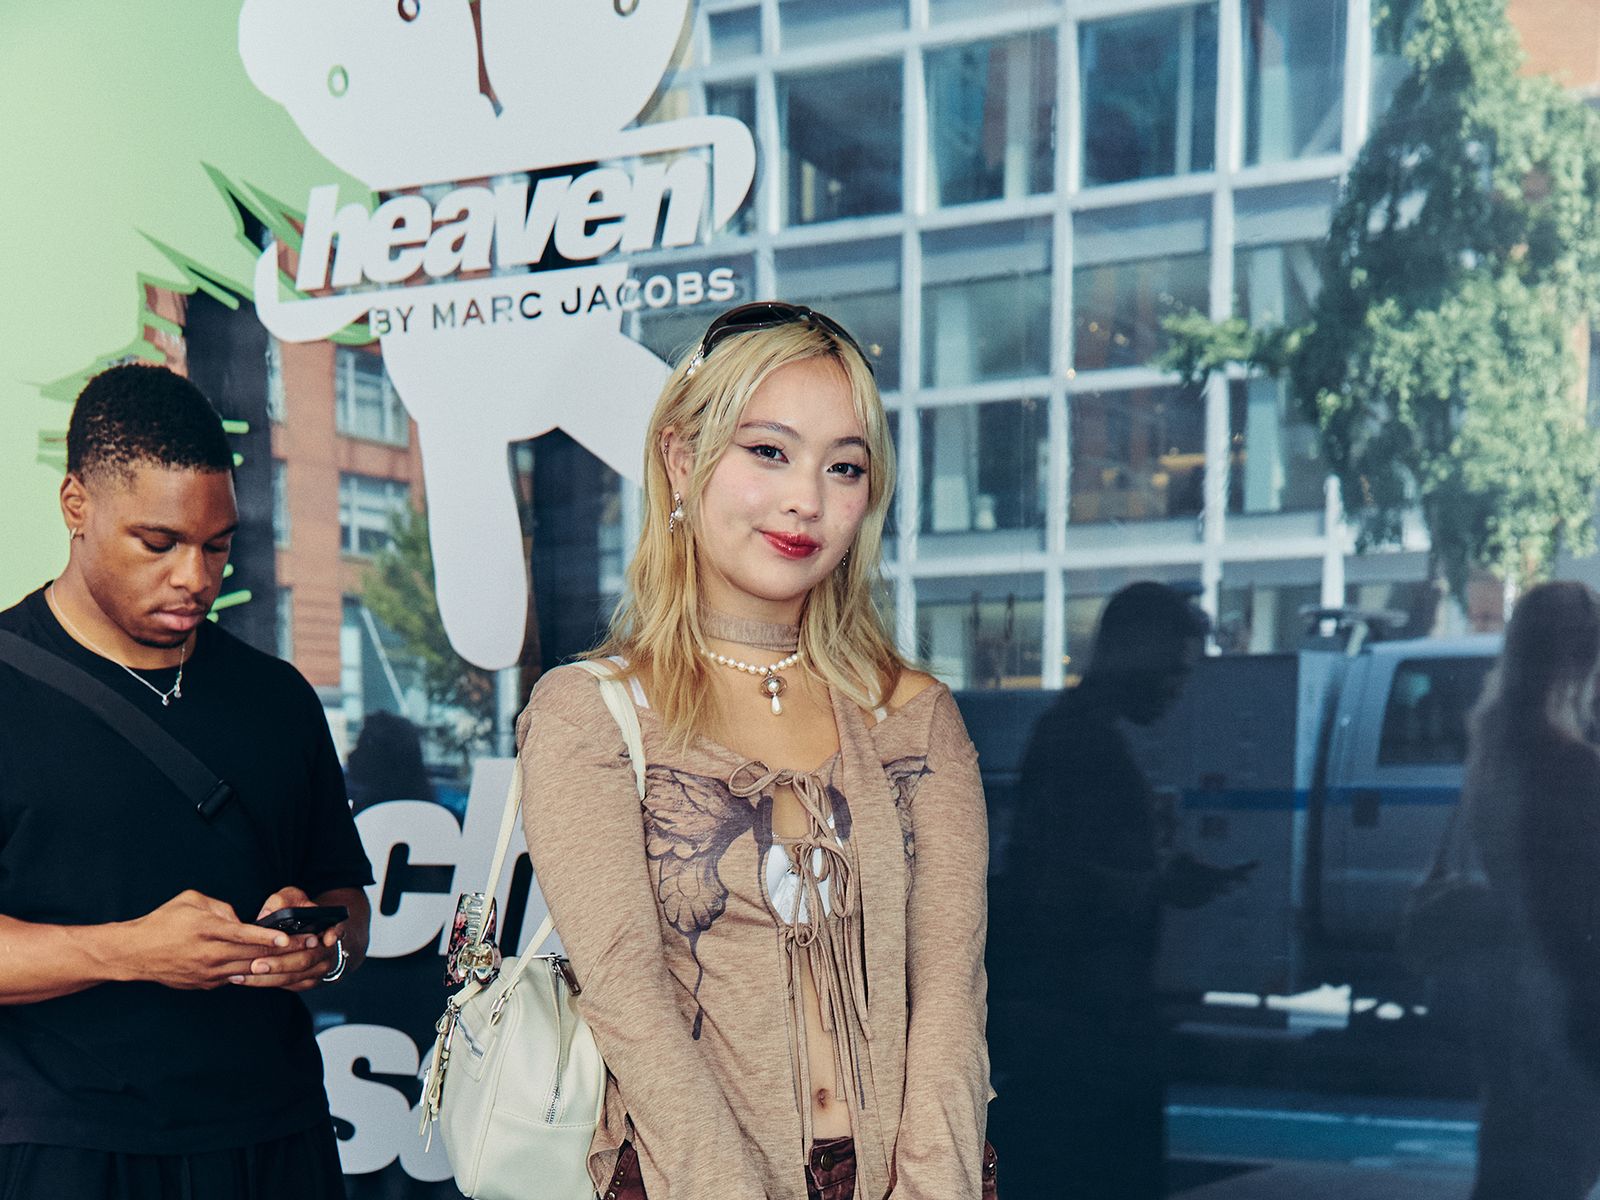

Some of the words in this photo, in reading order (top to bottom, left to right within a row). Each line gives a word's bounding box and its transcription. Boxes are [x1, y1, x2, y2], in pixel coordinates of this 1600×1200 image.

[296, 159, 708, 290] heaven
[368, 305, 414, 336] BY
[432, 292, 542, 330] MARC
[561, 267, 736, 315] JACOBS
